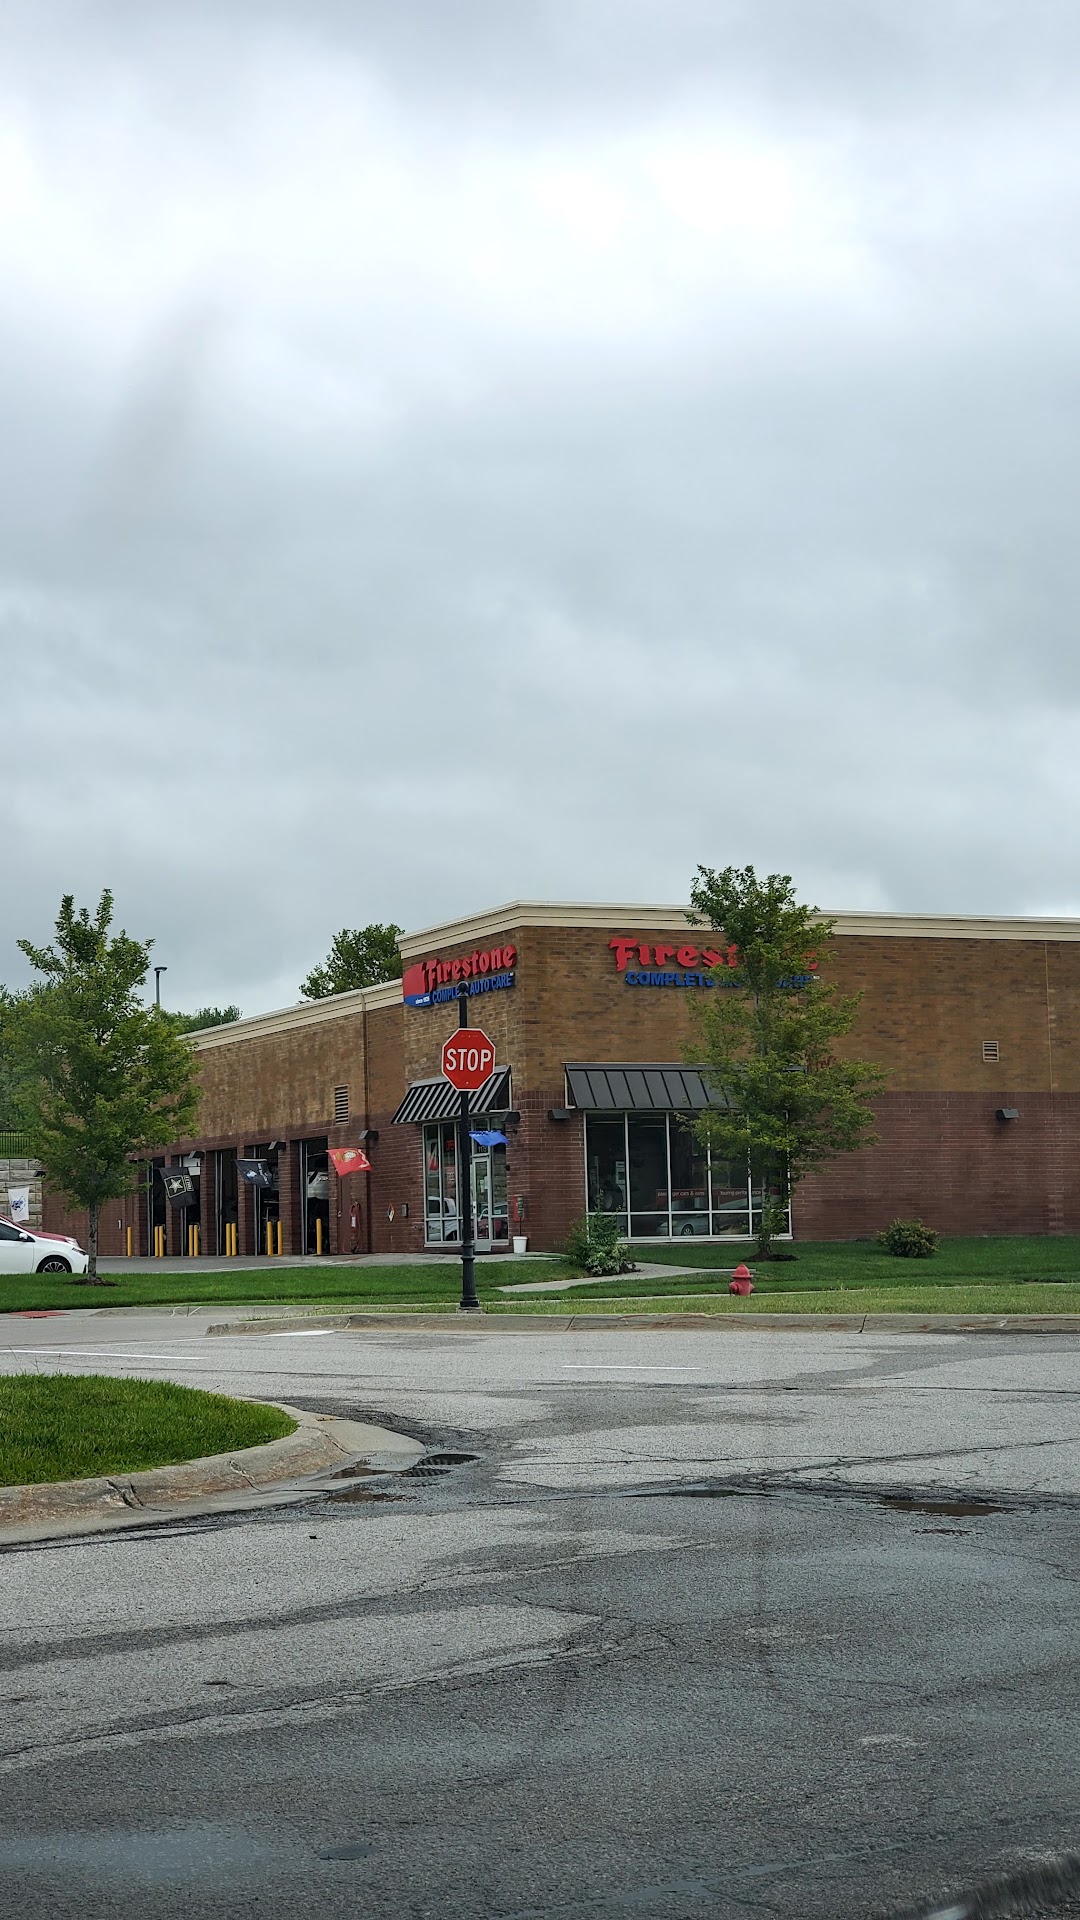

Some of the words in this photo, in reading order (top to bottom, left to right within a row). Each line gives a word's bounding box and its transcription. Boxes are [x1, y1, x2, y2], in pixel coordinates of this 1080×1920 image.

[426, 945, 517, 992] Firestone
[432, 986, 462, 1004] COMPLE
[469, 978, 491, 996] AUTO
[492, 972, 513, 992] CARE
[446, 1048, 492, 1071] STOP
